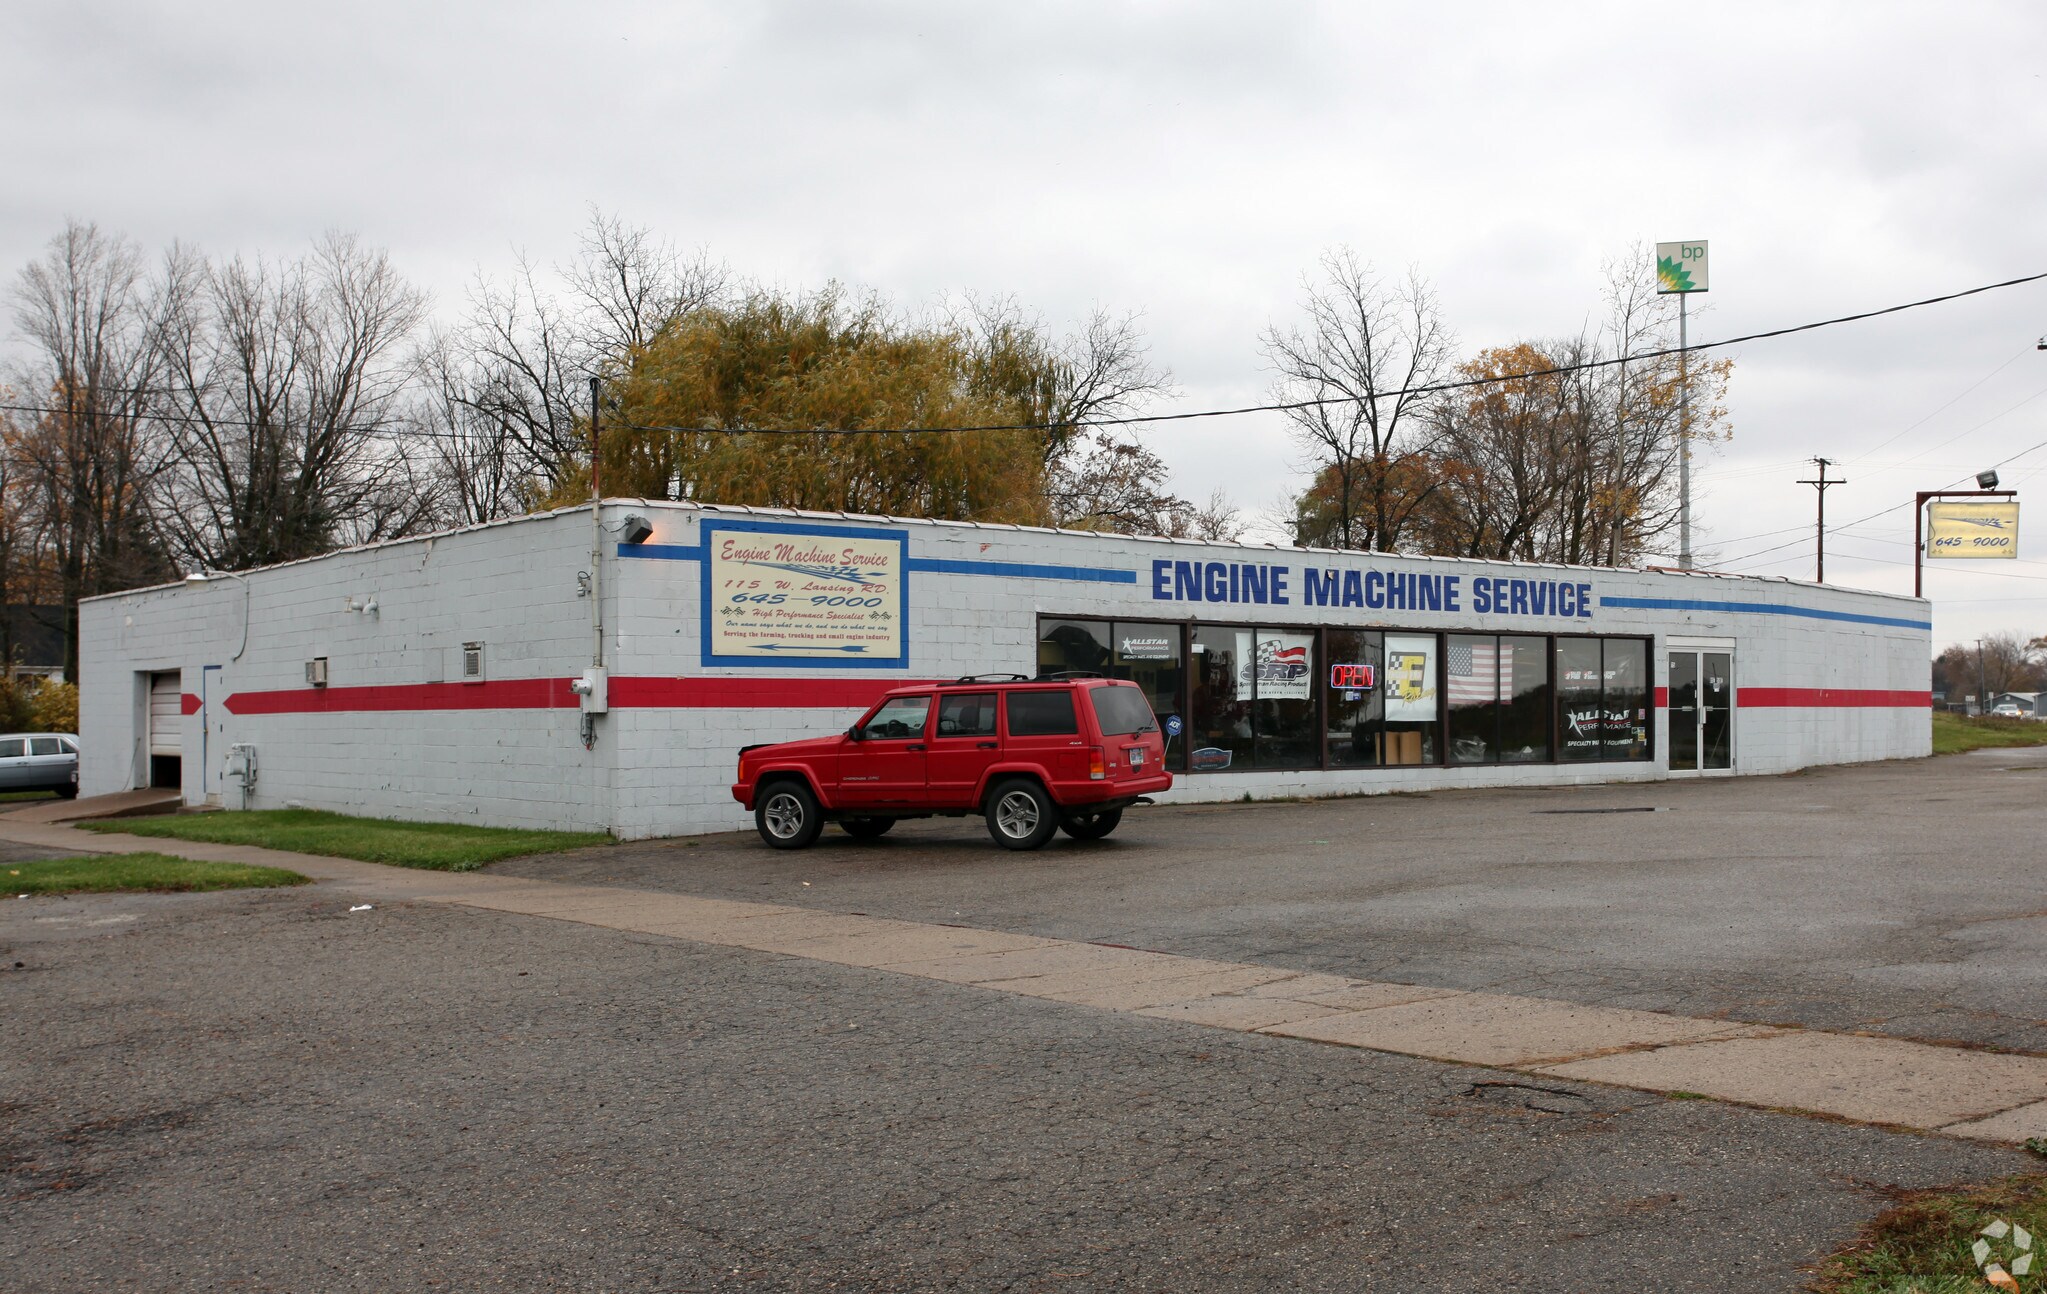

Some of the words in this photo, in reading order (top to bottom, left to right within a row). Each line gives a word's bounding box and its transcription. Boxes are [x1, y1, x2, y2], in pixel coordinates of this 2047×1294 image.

[1682, 244, 1704, 262] bp
[721, 540, 770, 565] Engine
[774, 543, 836, 564] Machine
[839, 548, 889, 567] Service
[724, 579, 762, 589] 115
[774, 580, 795, 591] W.
[801, 581, 855, 594] Lansing
[860, 583, 890, 595] RD.
[1152, 559, 1289, 605] ENGINE
[1304, 567, 1460, 612] MACHINE
[1473, 577, 1592, 617] SERVICE
[752, 608, 773, 619] High
[776, 609, 824, 620] Performance
[826, 611, 865, 620] Specialist
[1241, 662, 1310, 682] SRP
[1333, 666, 1373, 687] OPEN
